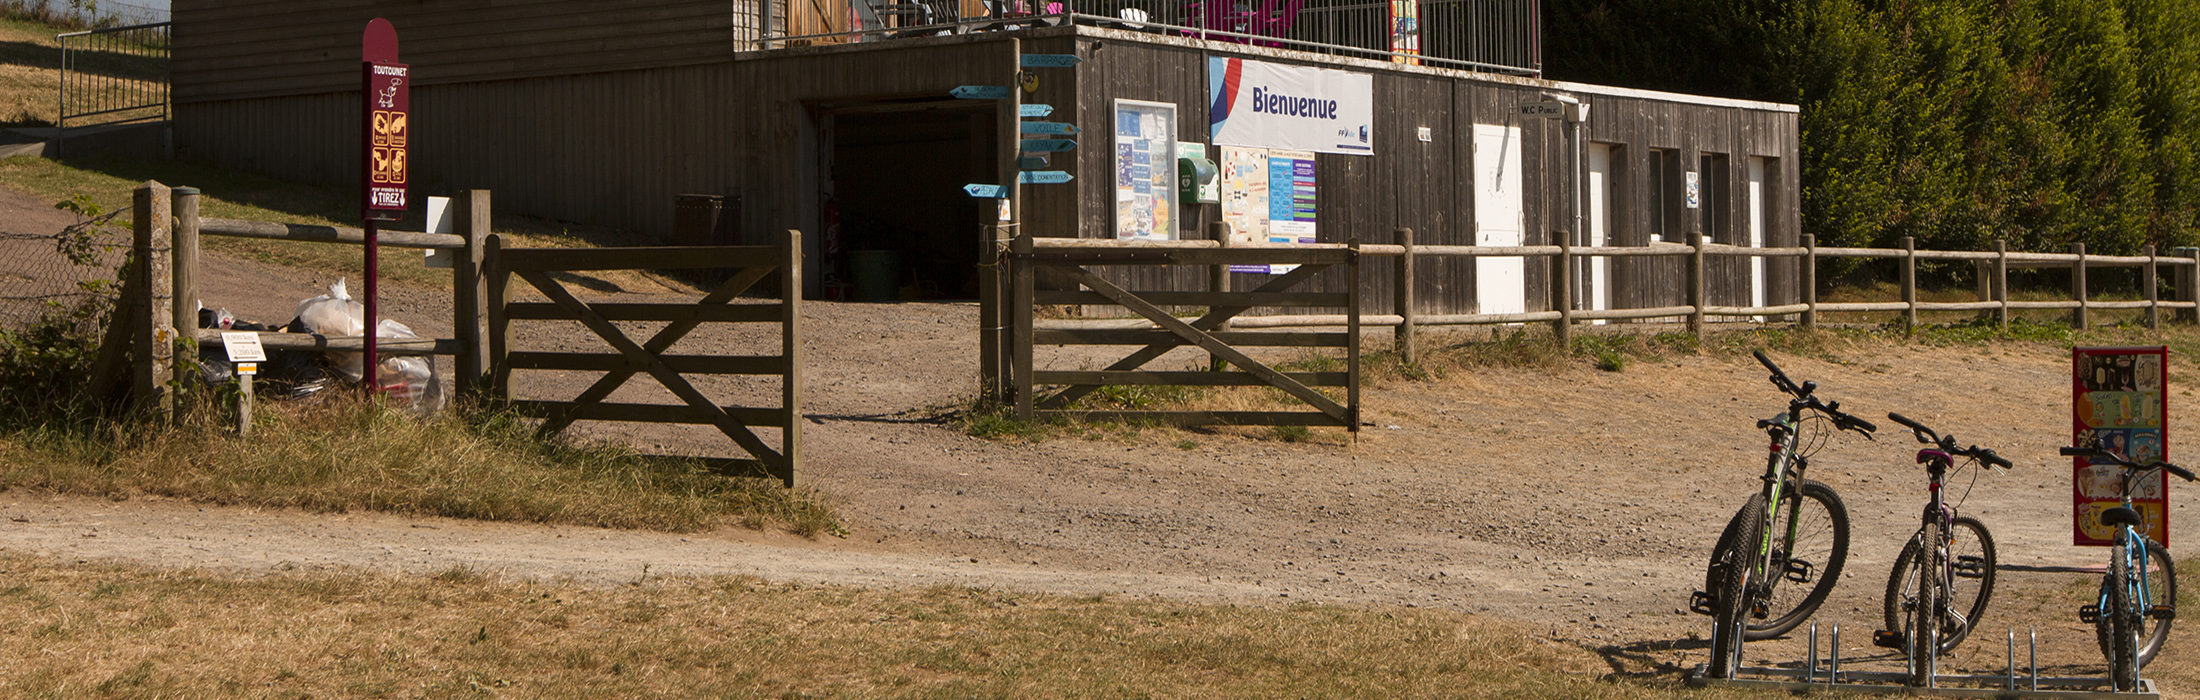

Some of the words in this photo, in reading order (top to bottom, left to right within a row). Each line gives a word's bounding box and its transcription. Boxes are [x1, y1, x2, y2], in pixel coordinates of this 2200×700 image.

[1027, 55, 1071, 65] BARRAGE
[373, 65, 407, 77] TOUTOUNET
[1253, 85, 1337, 120] Bienvenue
[1033, 123, 1060, 133] VOILE
[378, 193, 400, 203] TIREZ
